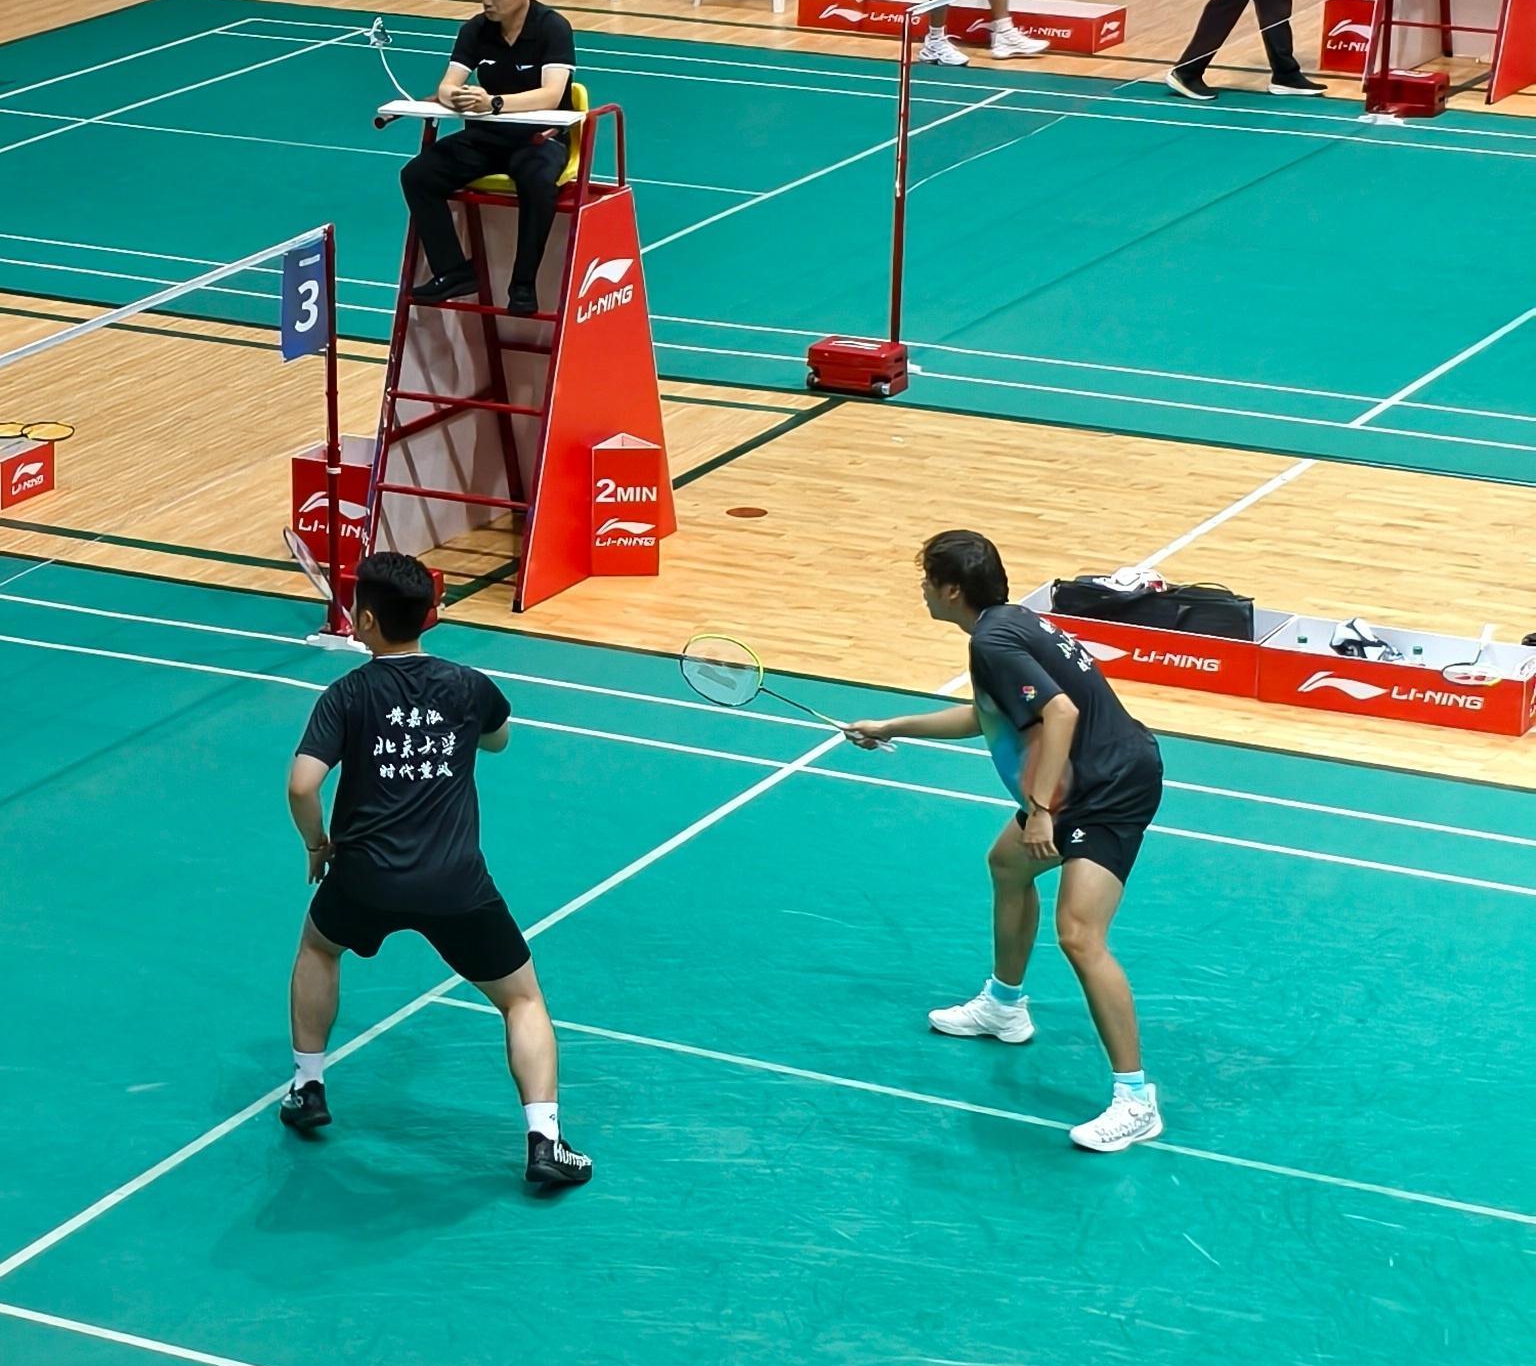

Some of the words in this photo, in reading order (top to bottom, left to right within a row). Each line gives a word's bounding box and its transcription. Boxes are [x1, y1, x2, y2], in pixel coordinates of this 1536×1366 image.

[869, 11, 921, 25] LI-NIG
[295, 280, 319, 332] 3
[577, 284, 634, 324] LI-NING
[11, 474, 44, 496] LI-NING
[595, 478, 657, 503] 2MIN
[595, 537, 656, 547] LI-NING
[1132, 648, 1222, 672] LI-NING
[1391, 686, 1484, 710] LI-NING
